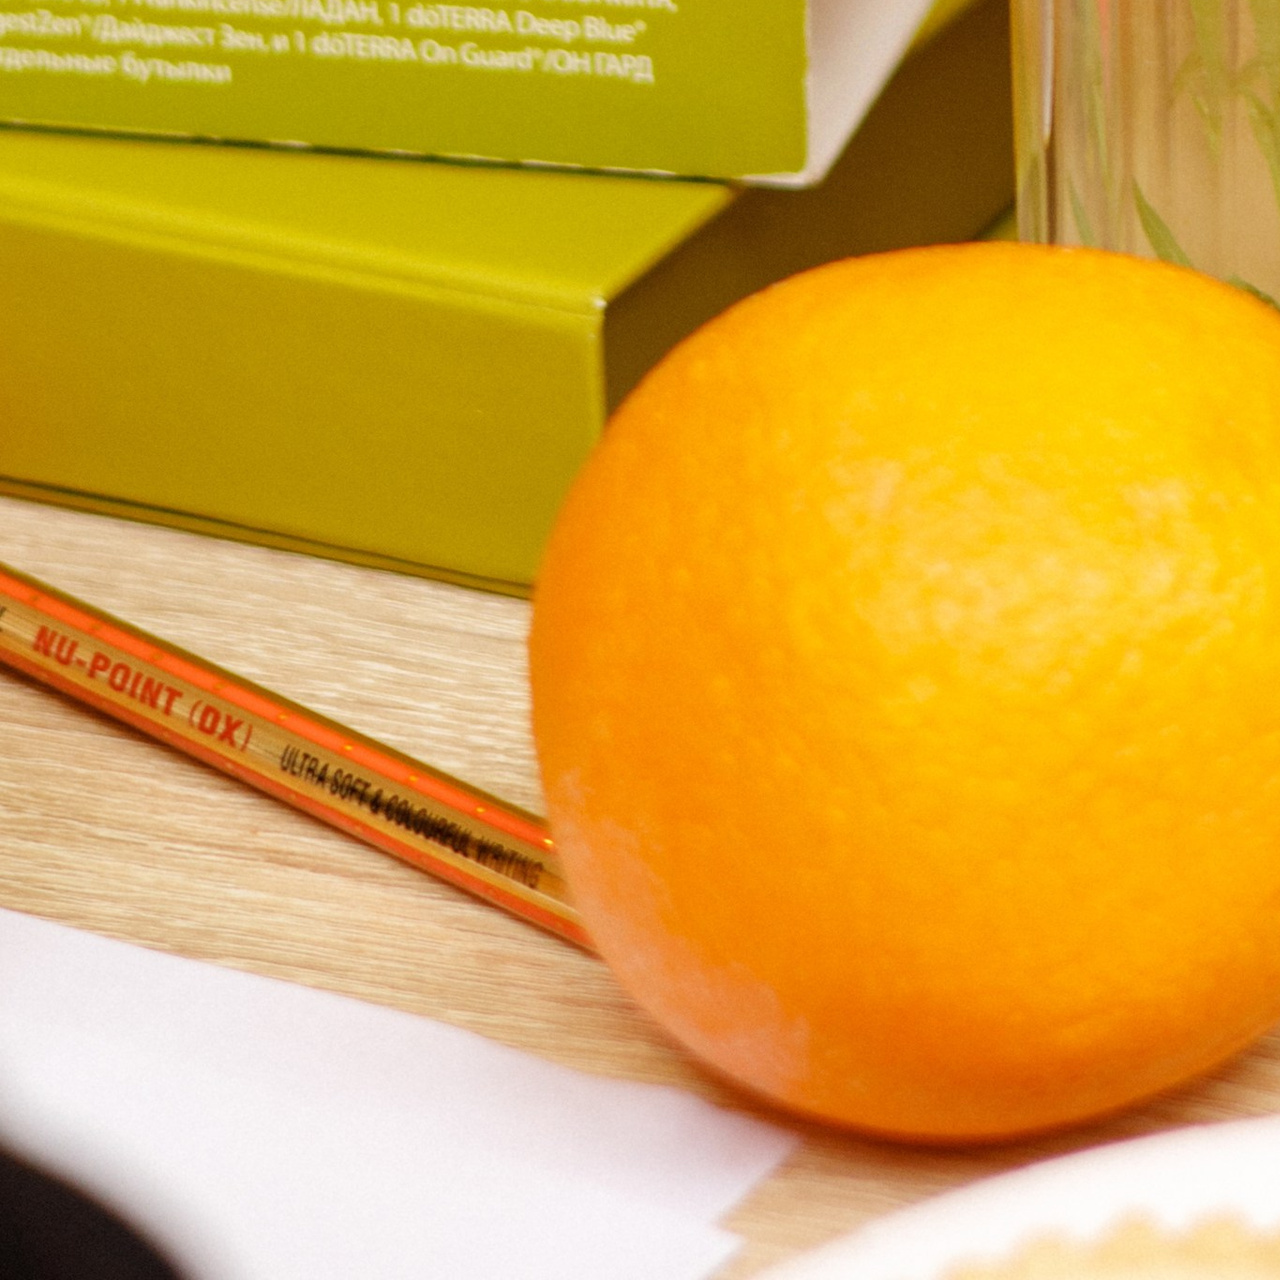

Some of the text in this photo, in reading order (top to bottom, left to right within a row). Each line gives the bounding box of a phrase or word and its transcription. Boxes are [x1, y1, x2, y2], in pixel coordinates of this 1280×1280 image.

[515, 10, 581, 43] Deep
[120, 51, 232, 84] бутылки
[419, 40, 457, 64] On
[594, 52, 655, 84] ГАРД
[32, 625, 253, 752] NU-POINT (DX)
[279, 744, 330, 785] ULTRA
[329, 768, 372, 807] SOFT
[384, 794, 474, 858] COLOURFUL
[475, 835, 545, 889] WRITING
